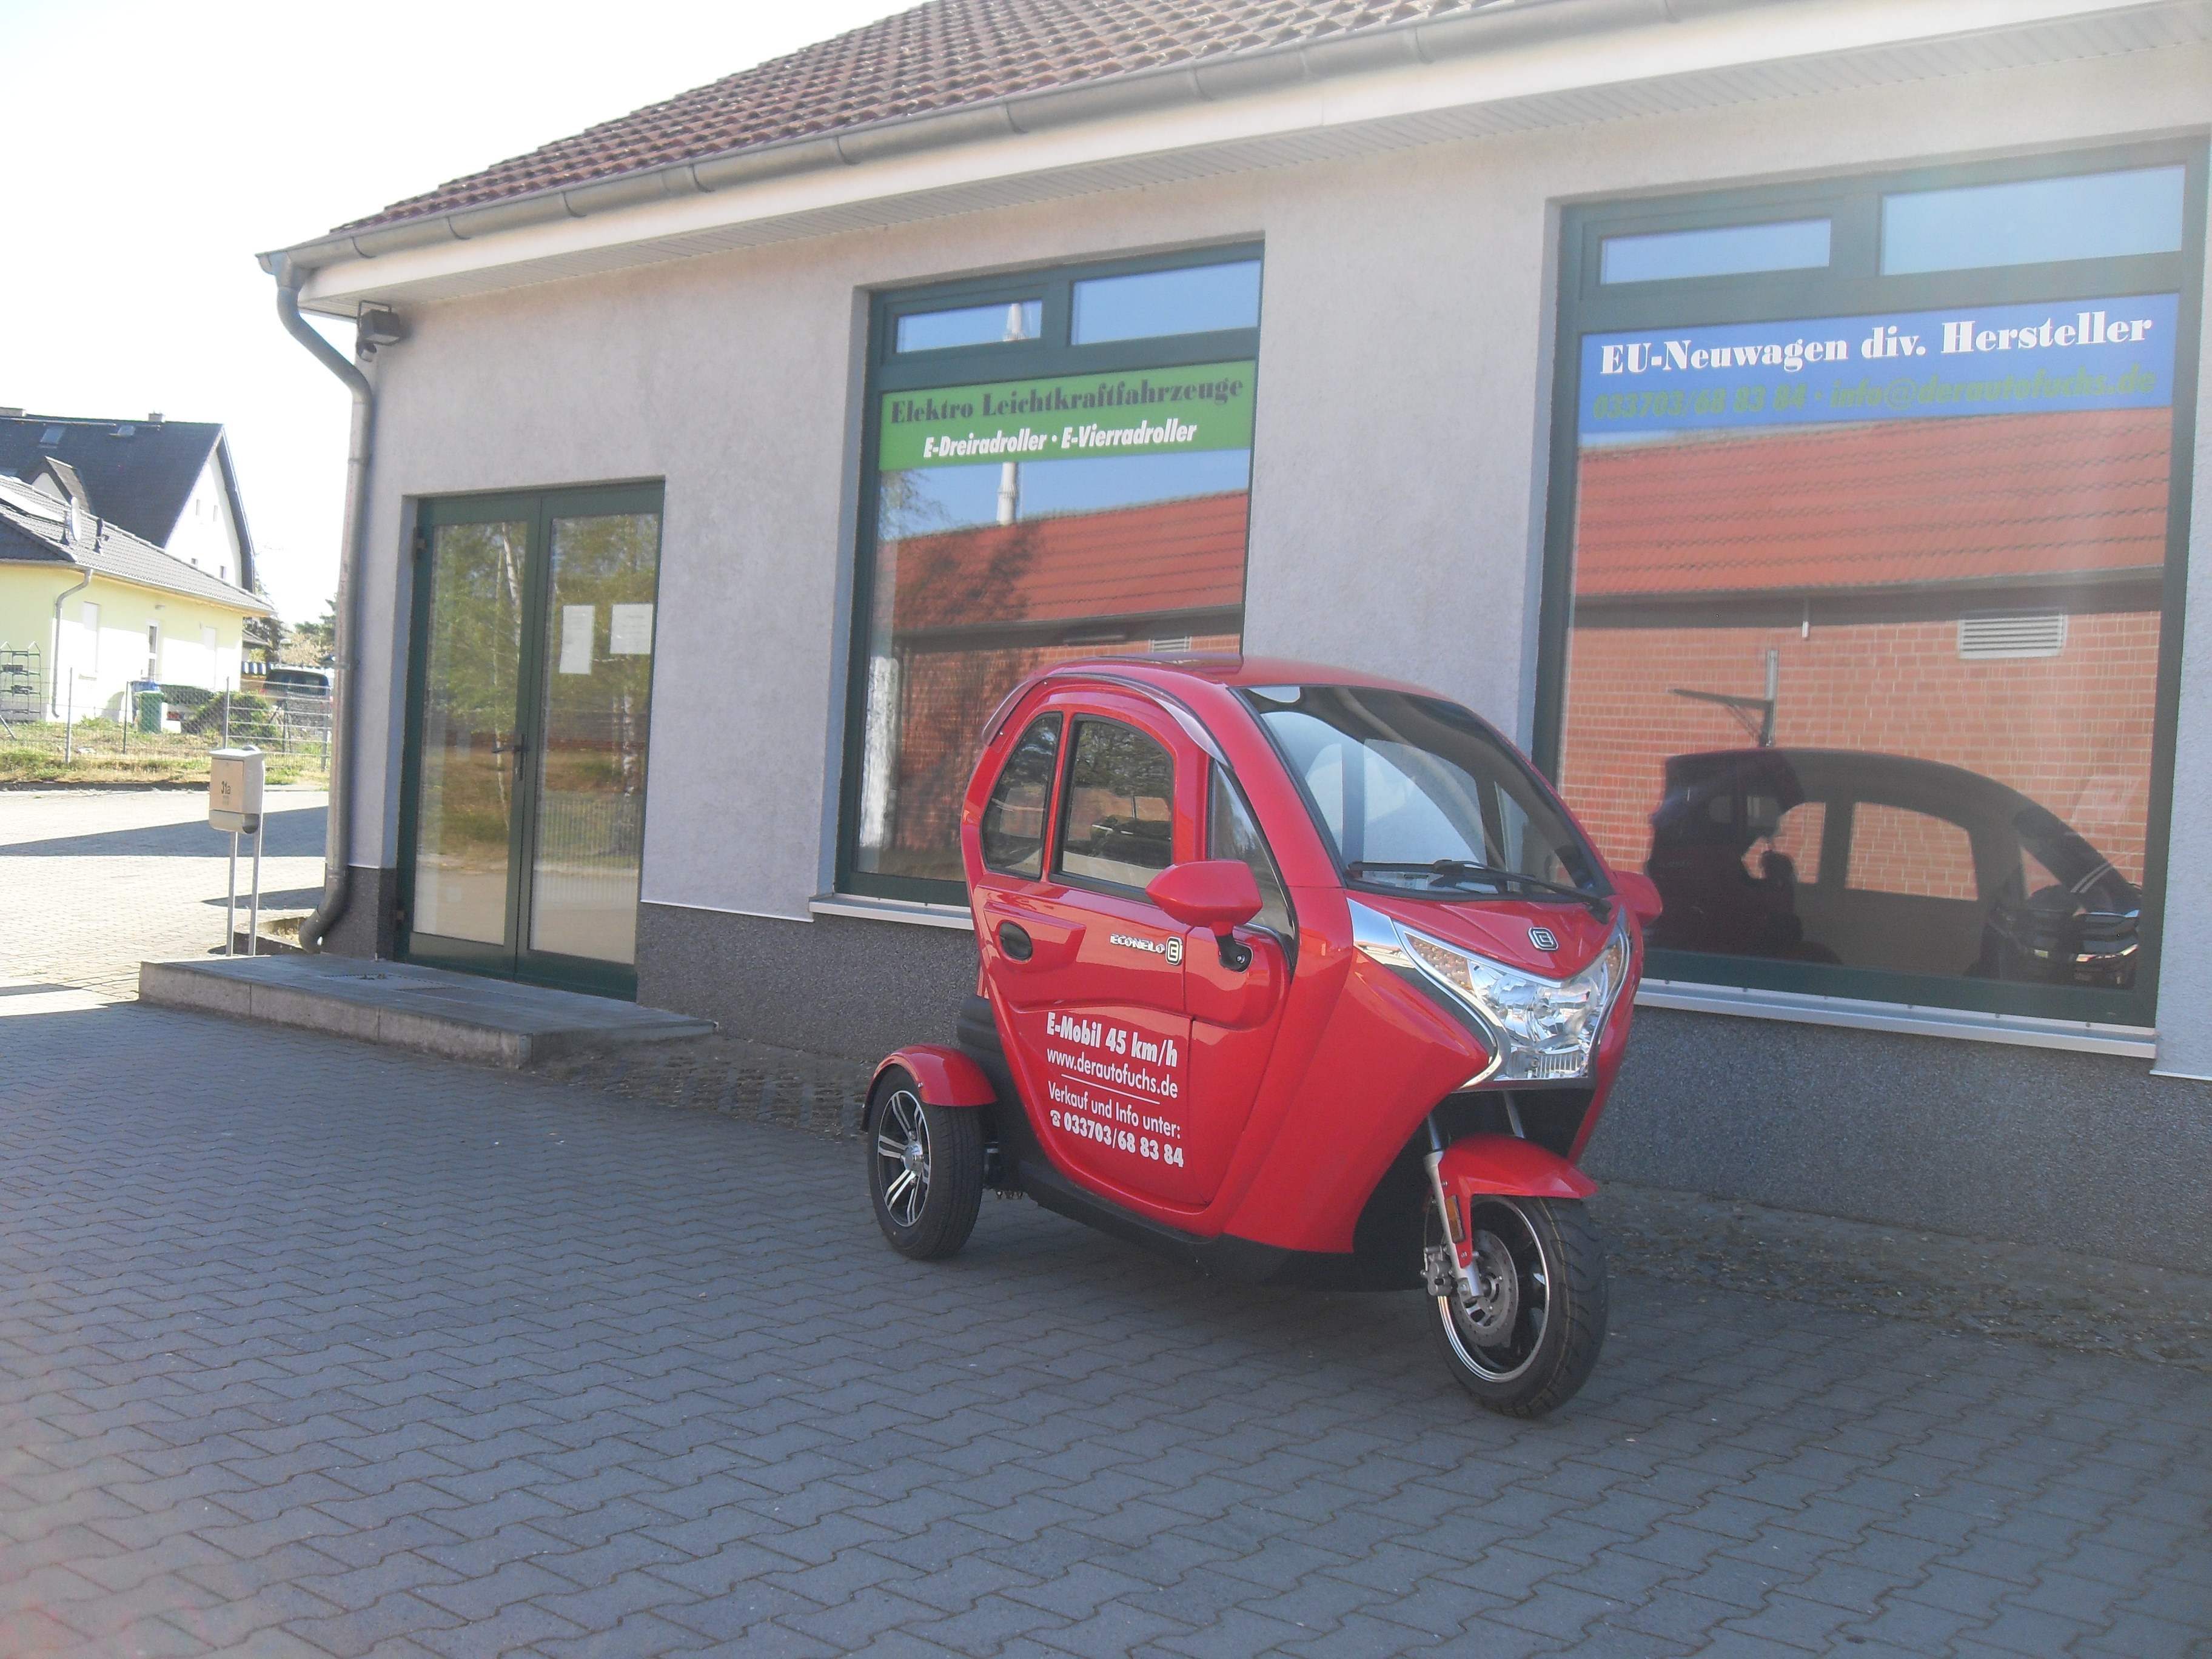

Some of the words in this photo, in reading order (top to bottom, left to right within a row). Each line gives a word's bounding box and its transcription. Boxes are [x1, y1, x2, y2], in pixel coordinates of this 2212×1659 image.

[1600, 339, 1848, 374] EU-Neuwagen
[1860, 326, 1927, 359] div.
[1940, 310, 2153, 353] Hersteller
[891, 397, 973, 423] Elektro
[983, 378, 1243, 416] Leichtkraftfahrzeuge
[1594, 388, 1727, 419] 033703/68
[1732, 384, 1767, 412] 83
[1772, 382, 1808, 412] 84
[1829, 363, 2157, 411] info@derautofuchs.de
[923, 428, 1047, 458] E-Dreiradroller
[1061, 418, 1197, 449] E-Vierradroller
[1110, 934, 1165, 953] ECONELO
[1047, 1011, 1102, 1048] E-Mobil
[1105, 1028, 1127, 1055] 45
[1131, 1031, 1178, 1068] km/h
[1047, 1048, 1178, 1099] www.derautofuchs.de
[1048, 1081, 1088, 1111] Verkauf
[1091, 1099, 1112, 1119] und
[1116, 1102, 1139, 1127] Info
[1142, 1114, 1181, 1140] unter:
[1064, 1111, 1136, 1153] 033703/68
[1139, 1136, 1159, 1161] 83
[1164, 1143, 1184, 1168] 84
